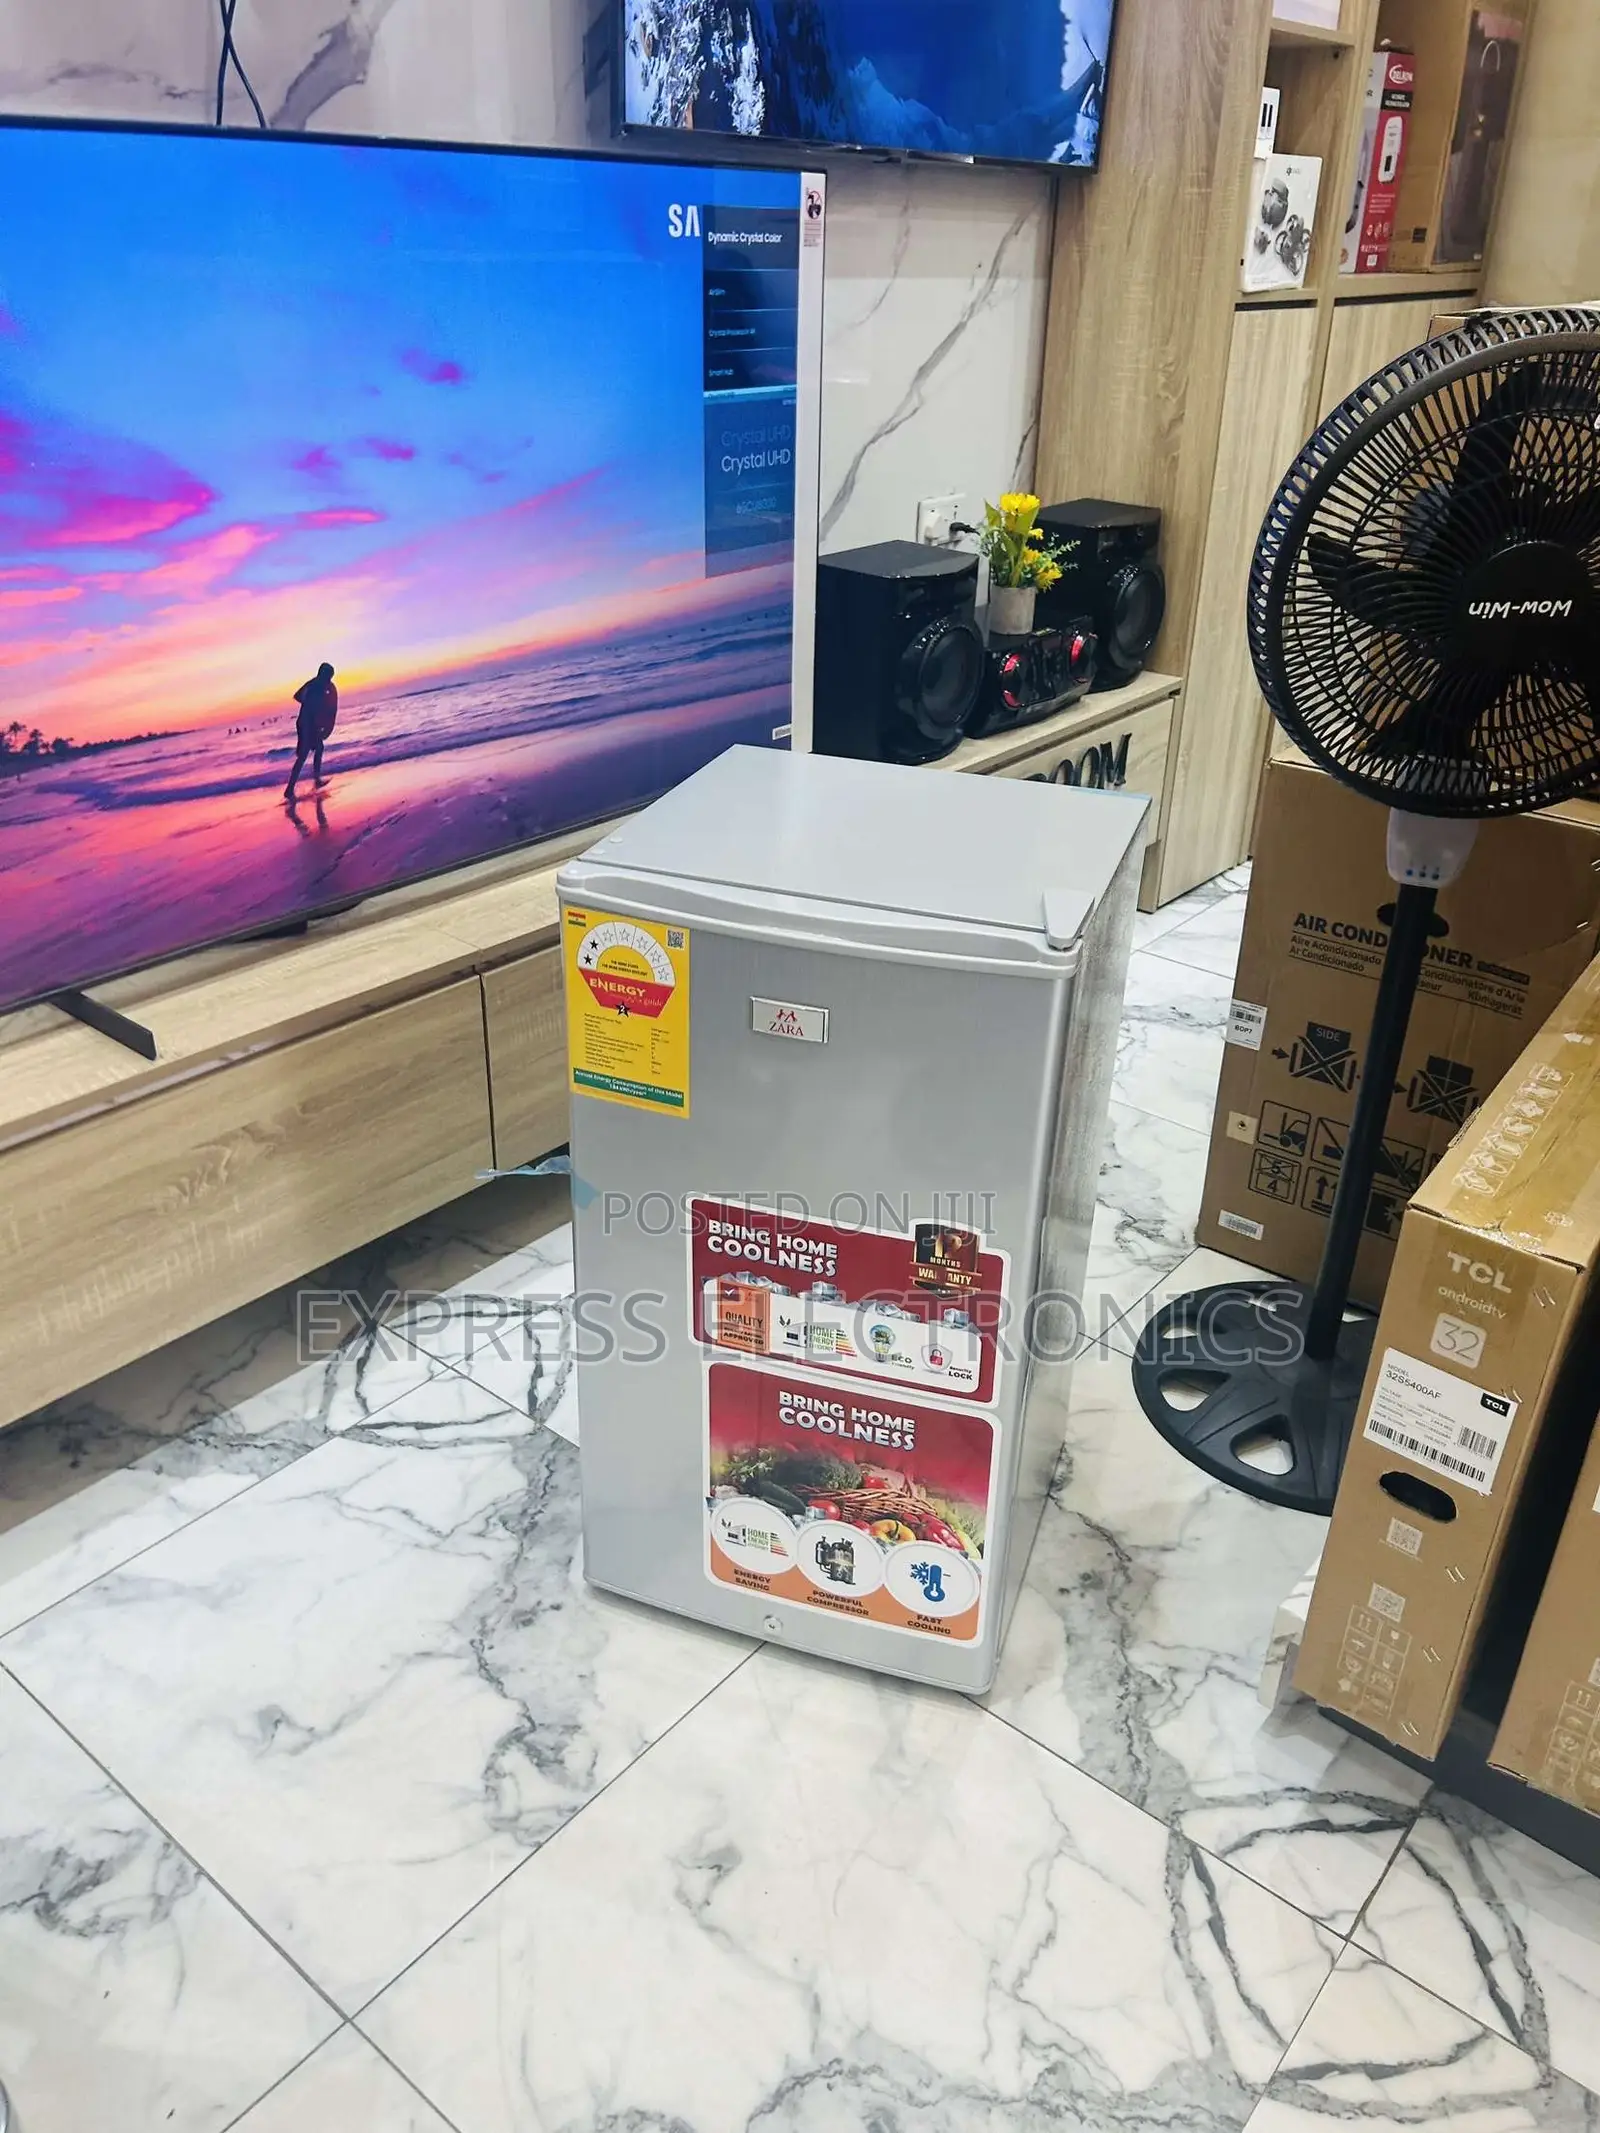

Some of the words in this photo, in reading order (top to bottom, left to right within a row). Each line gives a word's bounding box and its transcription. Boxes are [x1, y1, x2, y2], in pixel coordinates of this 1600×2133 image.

[708, 231, 739, 245] Dynamic
[740, 232, 763, 246] Crystal
[764, 233, 783, 243] Color
[721, 452, 766, 476] Crystal
[767, 448, 791, 467] UHD
[1293, 912, 1328, 934] AIR
[1291, 934, 1310, 947] Aire
[1312, 940, 1382, 965] Acondicionado
[1289, 945, 1301, 956] Ar
[1302, 948, 1365, 972] Condicionado
[589, 977, 646, 997] ENERGY
[620, 1005, 626, 1013] 2
[769, 1021, 804, 1037] ZARA
[1316, 1028, 1341, 1042] SIDE
[708, 1219, 771, 1245] BRING
[777, 1233, 838, 1259] HOME
[707, 1235, 837, 1277] COOLNESS
[930, 1255, 961, 1268] MONTHS
[918, 1267, 972, 1285] WAANTY
[1447, 1251, 1512, 1294] TCL
[725, 1311, 764, 1328] QUALITY
[723, 1331, 764, 1346] APPROVED
[809, 1325, 835, 1339] HOME
[1437, 1320, 1480, 1361] 32
[891, 1353, 913, 1365] ECO
[948, 1371, 973, 1380] LOCK
[1385, 1370, 1442, 1399] 32S5400AF
[779, 1391, 845, 1418] BRING
[851, 1407, 915, 1433] HOME
[1485, 1398, 1507, 1413] TCL
[778, 1407, 915, 1451] COOLNESS
[747, 1528, 769, 1540] HOME
[734, 1568, 771, 1583] ENERGY
[735, 1577, 770, 1591] SAVING
[807, 1596, 869, 1616] COMPRESSOR
[812, 1590, 864, 1607] POWERFUL
[907, 1620, 952, 1635] COOLING
[916, 1614, 943, 1625] FAST
